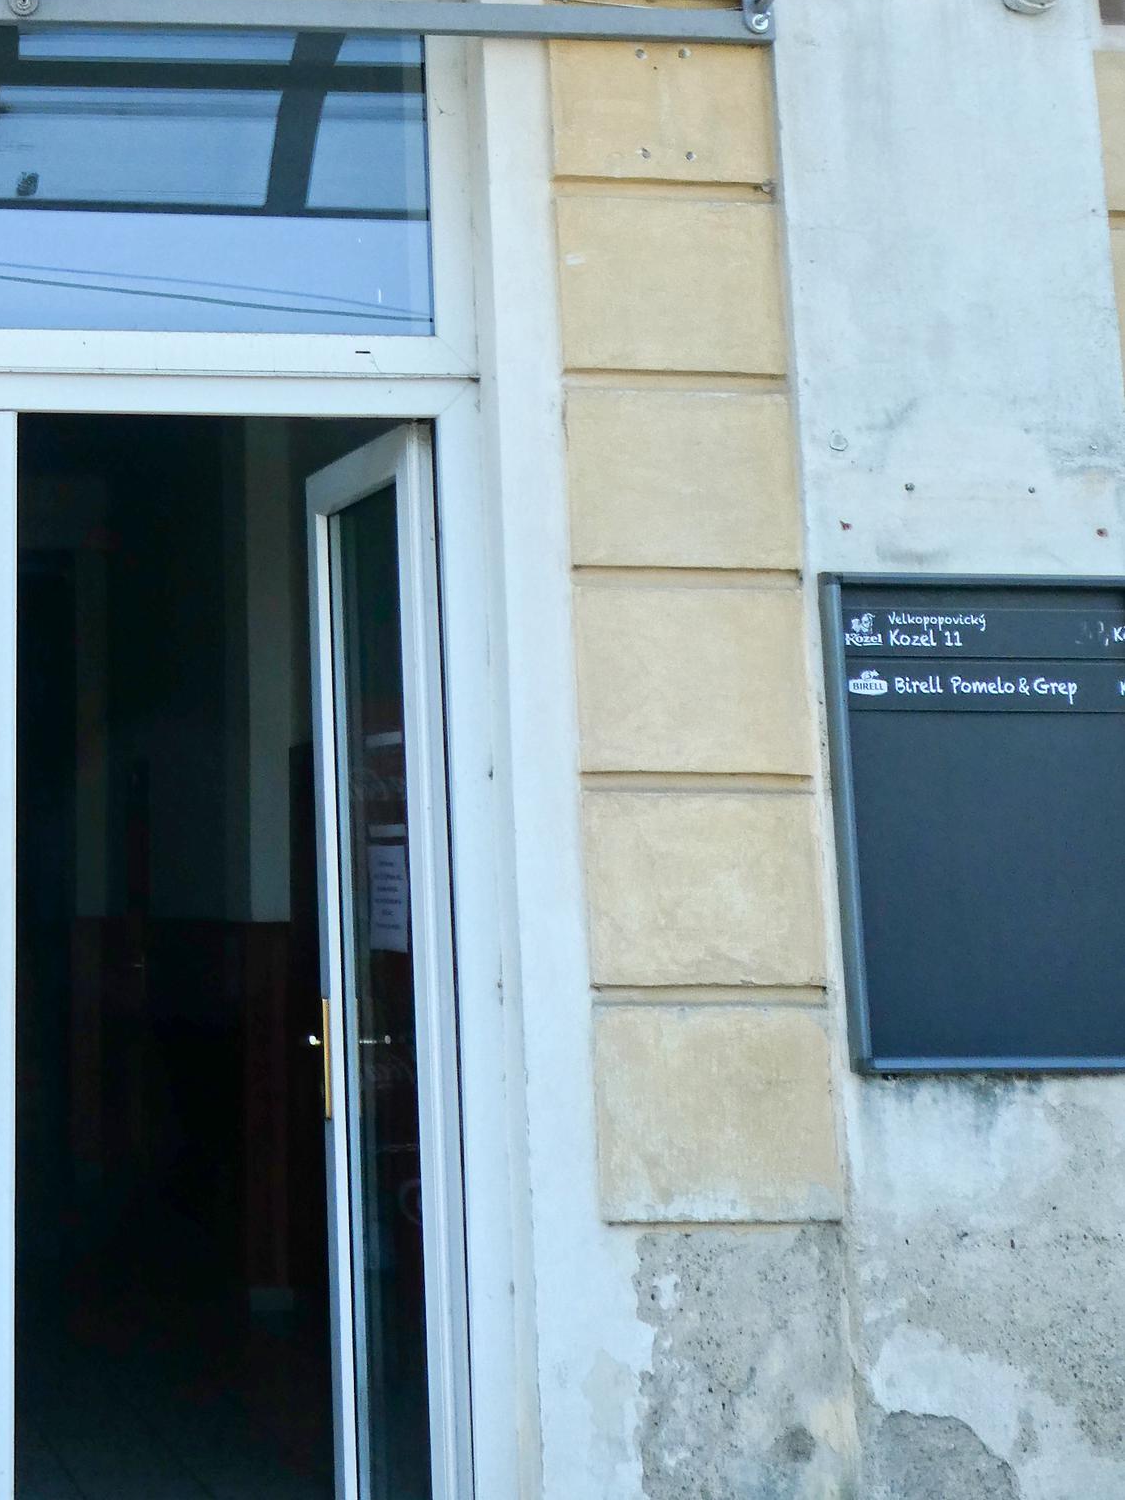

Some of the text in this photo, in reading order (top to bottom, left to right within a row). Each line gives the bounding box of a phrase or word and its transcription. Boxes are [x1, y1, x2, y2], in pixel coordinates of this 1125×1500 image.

[888, 611, 987, 632] Velkopopovický
[845, 632, 884, 647] Kozel
[889, 629, 937, 647] Kozel
[944, 631, 963, 647] 11
[852, 681, 885, 692] BIRELL
[894, 675, 1078, 705] Birell Pomelo & Grep
